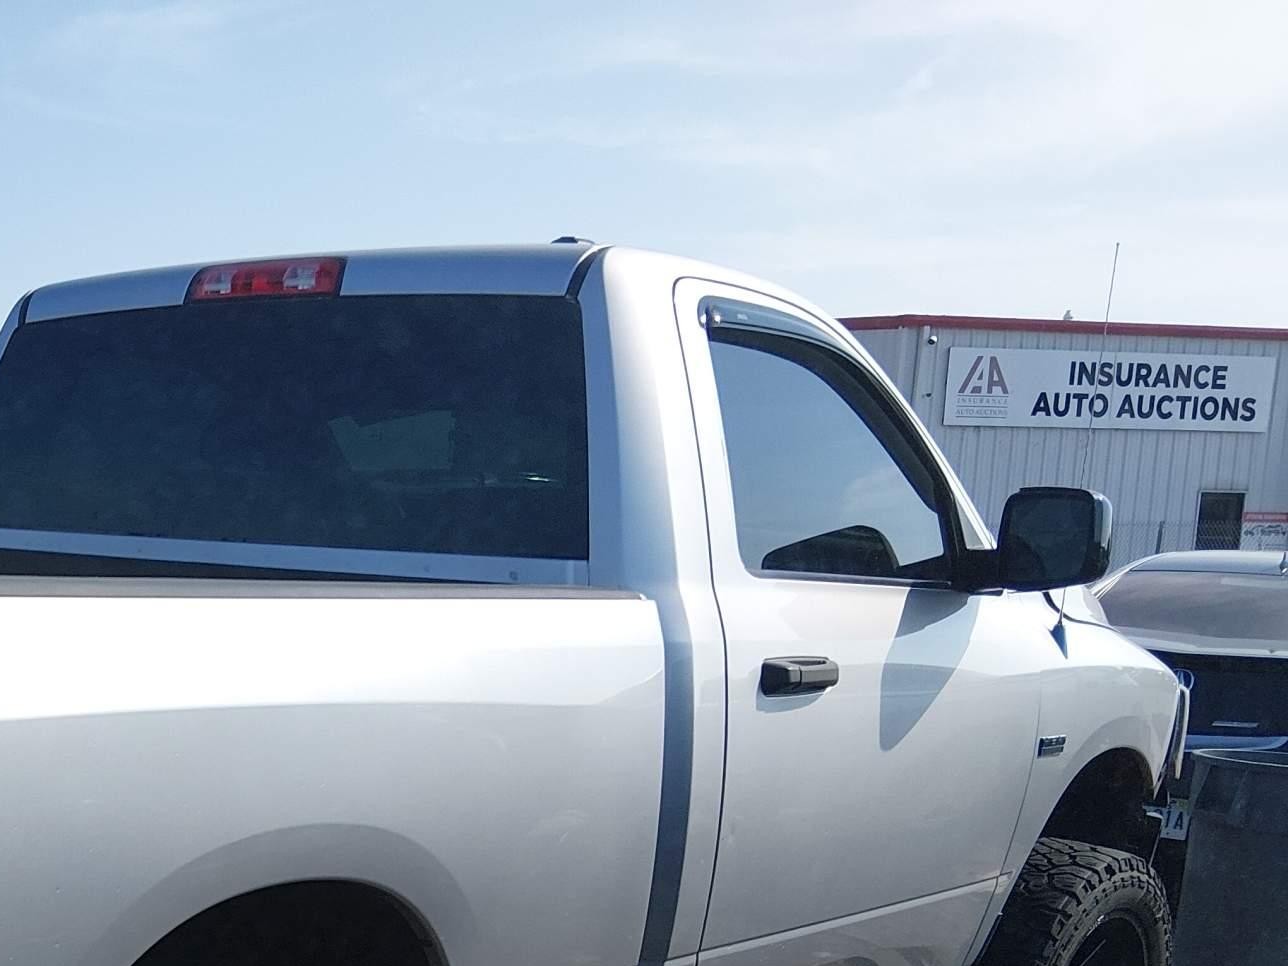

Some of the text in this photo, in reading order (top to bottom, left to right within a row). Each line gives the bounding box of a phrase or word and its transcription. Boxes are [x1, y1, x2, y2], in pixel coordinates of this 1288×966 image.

[1068, 361, 1229, 390] INSURANCE
[957, 397, 1008, 405] INSURANCE
[1031, 392, 1257, 422] AUTO AUCTIONS
